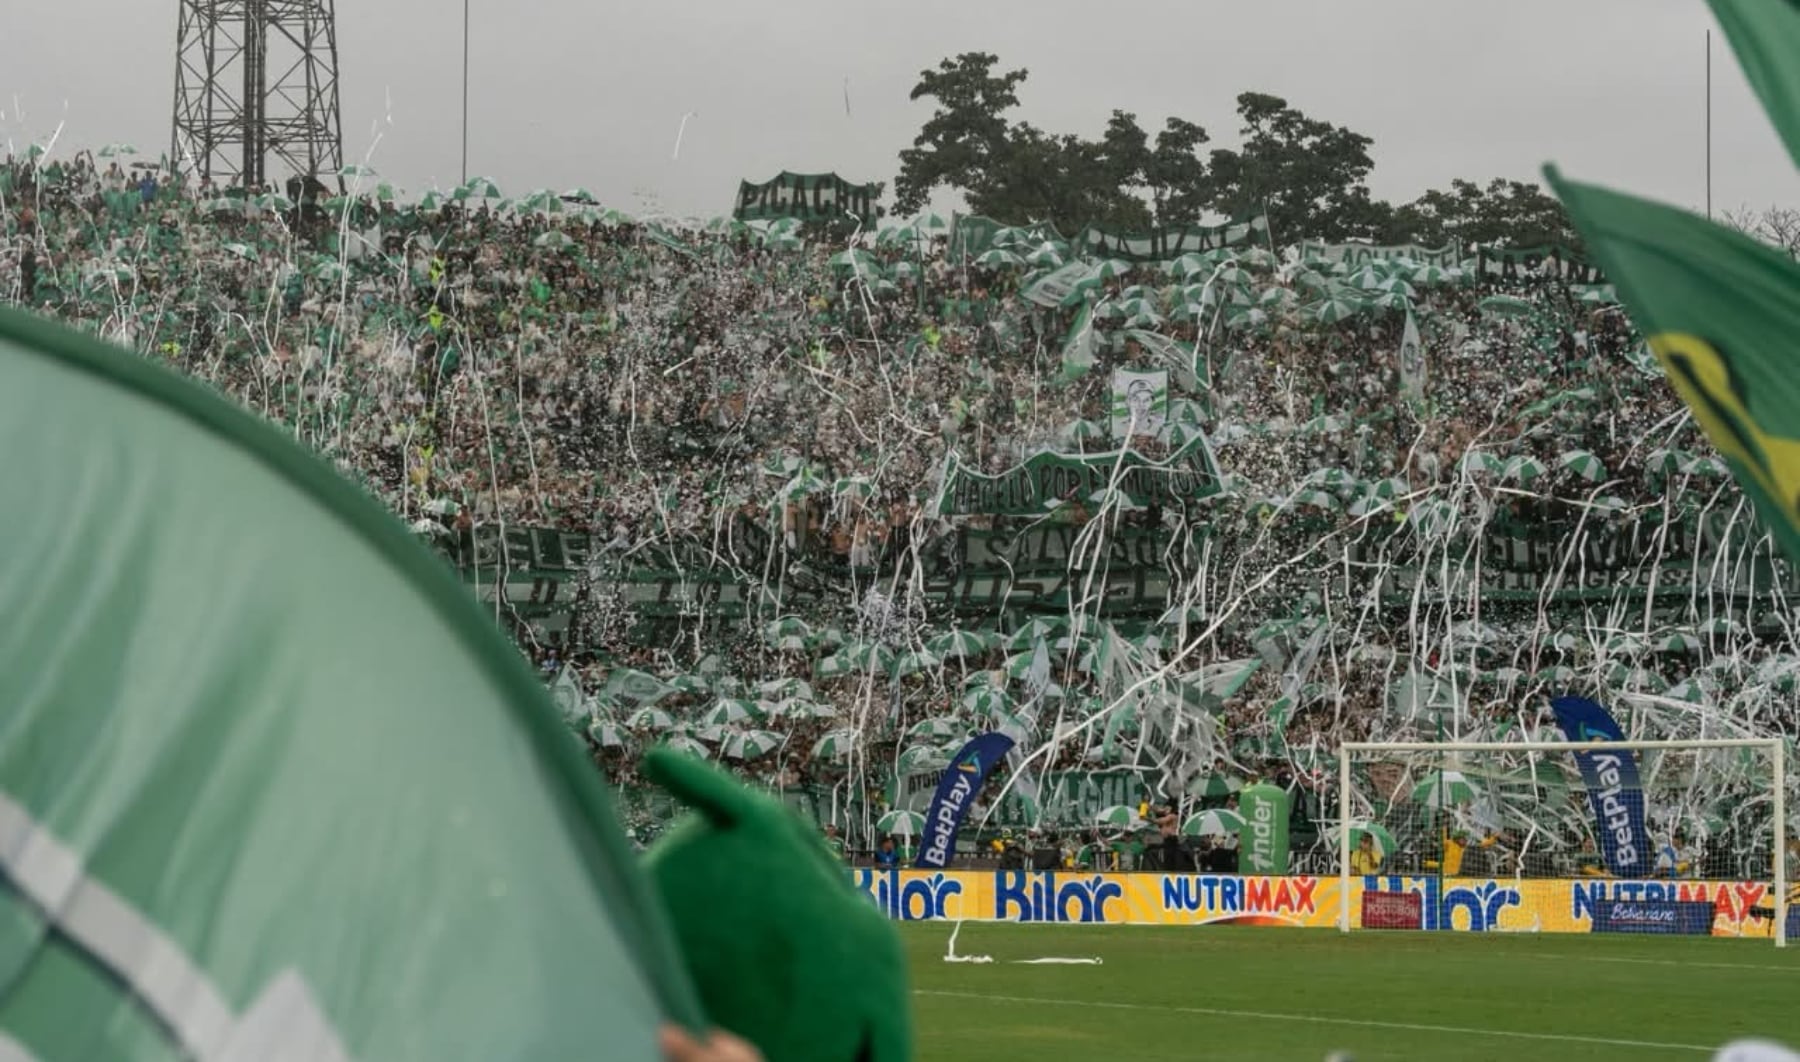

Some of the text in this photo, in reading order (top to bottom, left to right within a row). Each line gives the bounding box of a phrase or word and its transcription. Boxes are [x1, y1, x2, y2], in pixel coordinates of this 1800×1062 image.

[740, 174, 870, 223] PICACHO
[925, 773, 971, 867] BetPlay
[1592, 754, 1638, 867] BetPlay
[1163, 875, 1317, 914] NUTRIMAX
